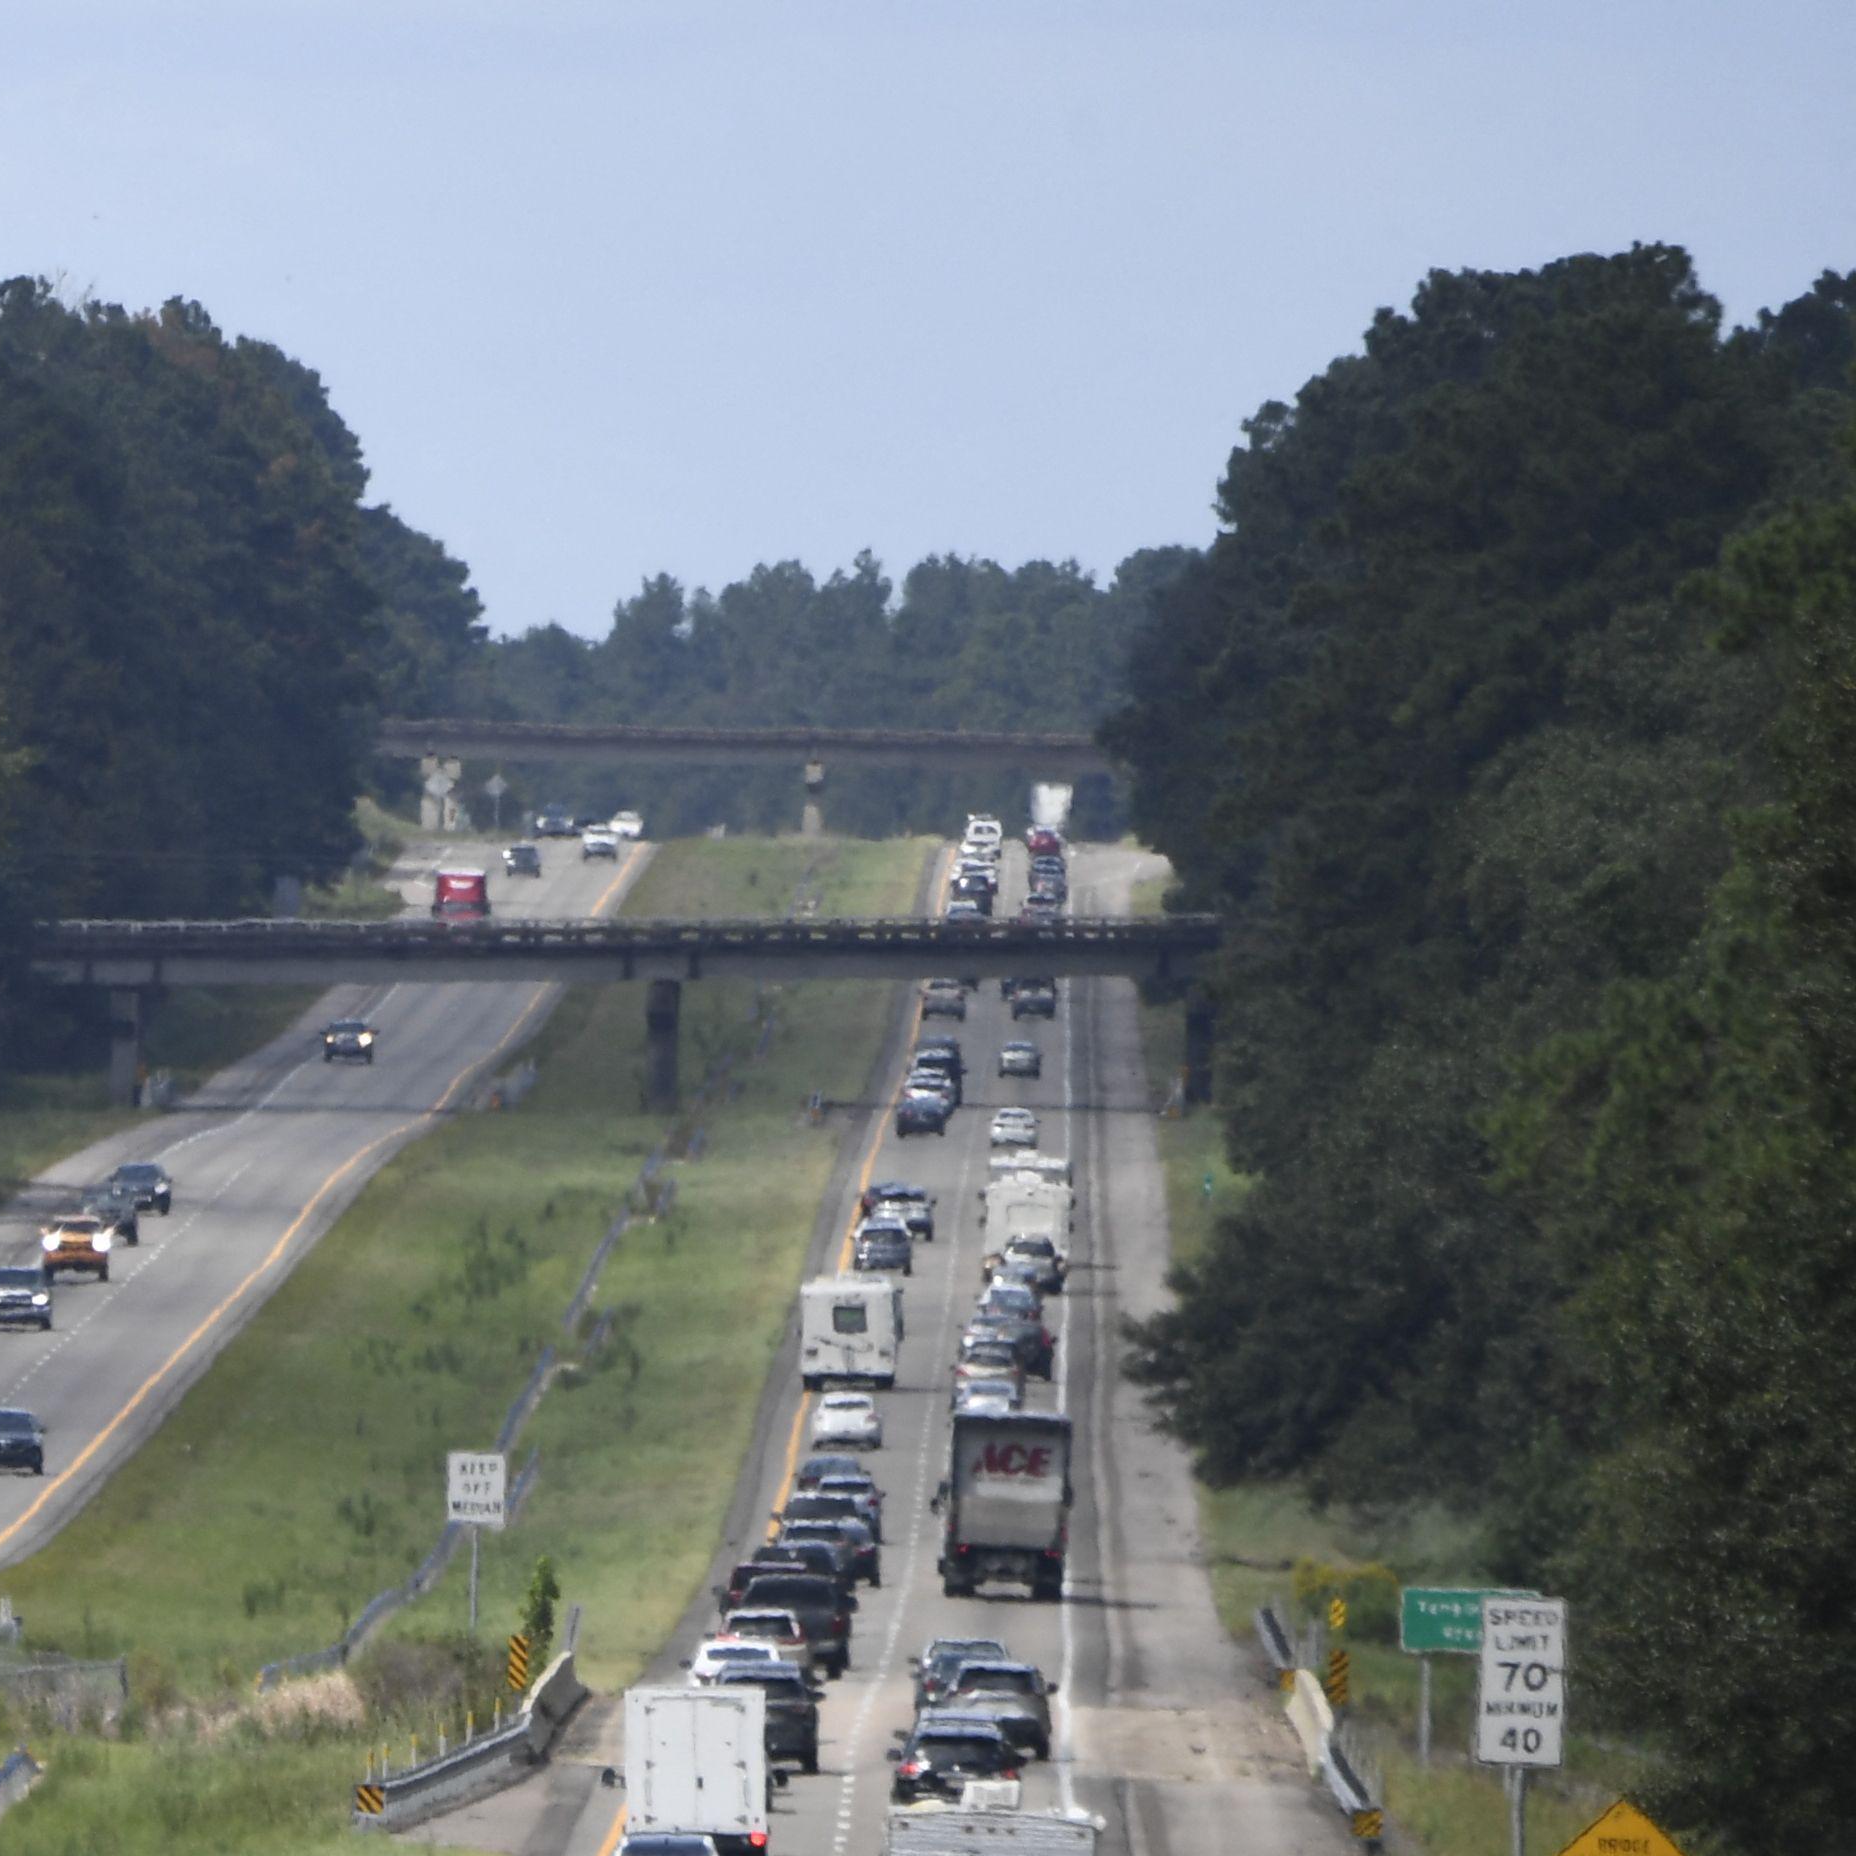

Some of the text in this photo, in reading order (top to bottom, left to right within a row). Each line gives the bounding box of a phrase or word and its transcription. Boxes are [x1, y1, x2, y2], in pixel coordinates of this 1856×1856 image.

[1489, 1608, 1559, 1626] SPEED
[1495, 1635, 1549, 1651] LIMIT
[1497, 1661, 1548, 1692] 70
[1486, 1702, 1558, 1718] MINIMUM
[1500, 1727, 1542, 1754] 40
